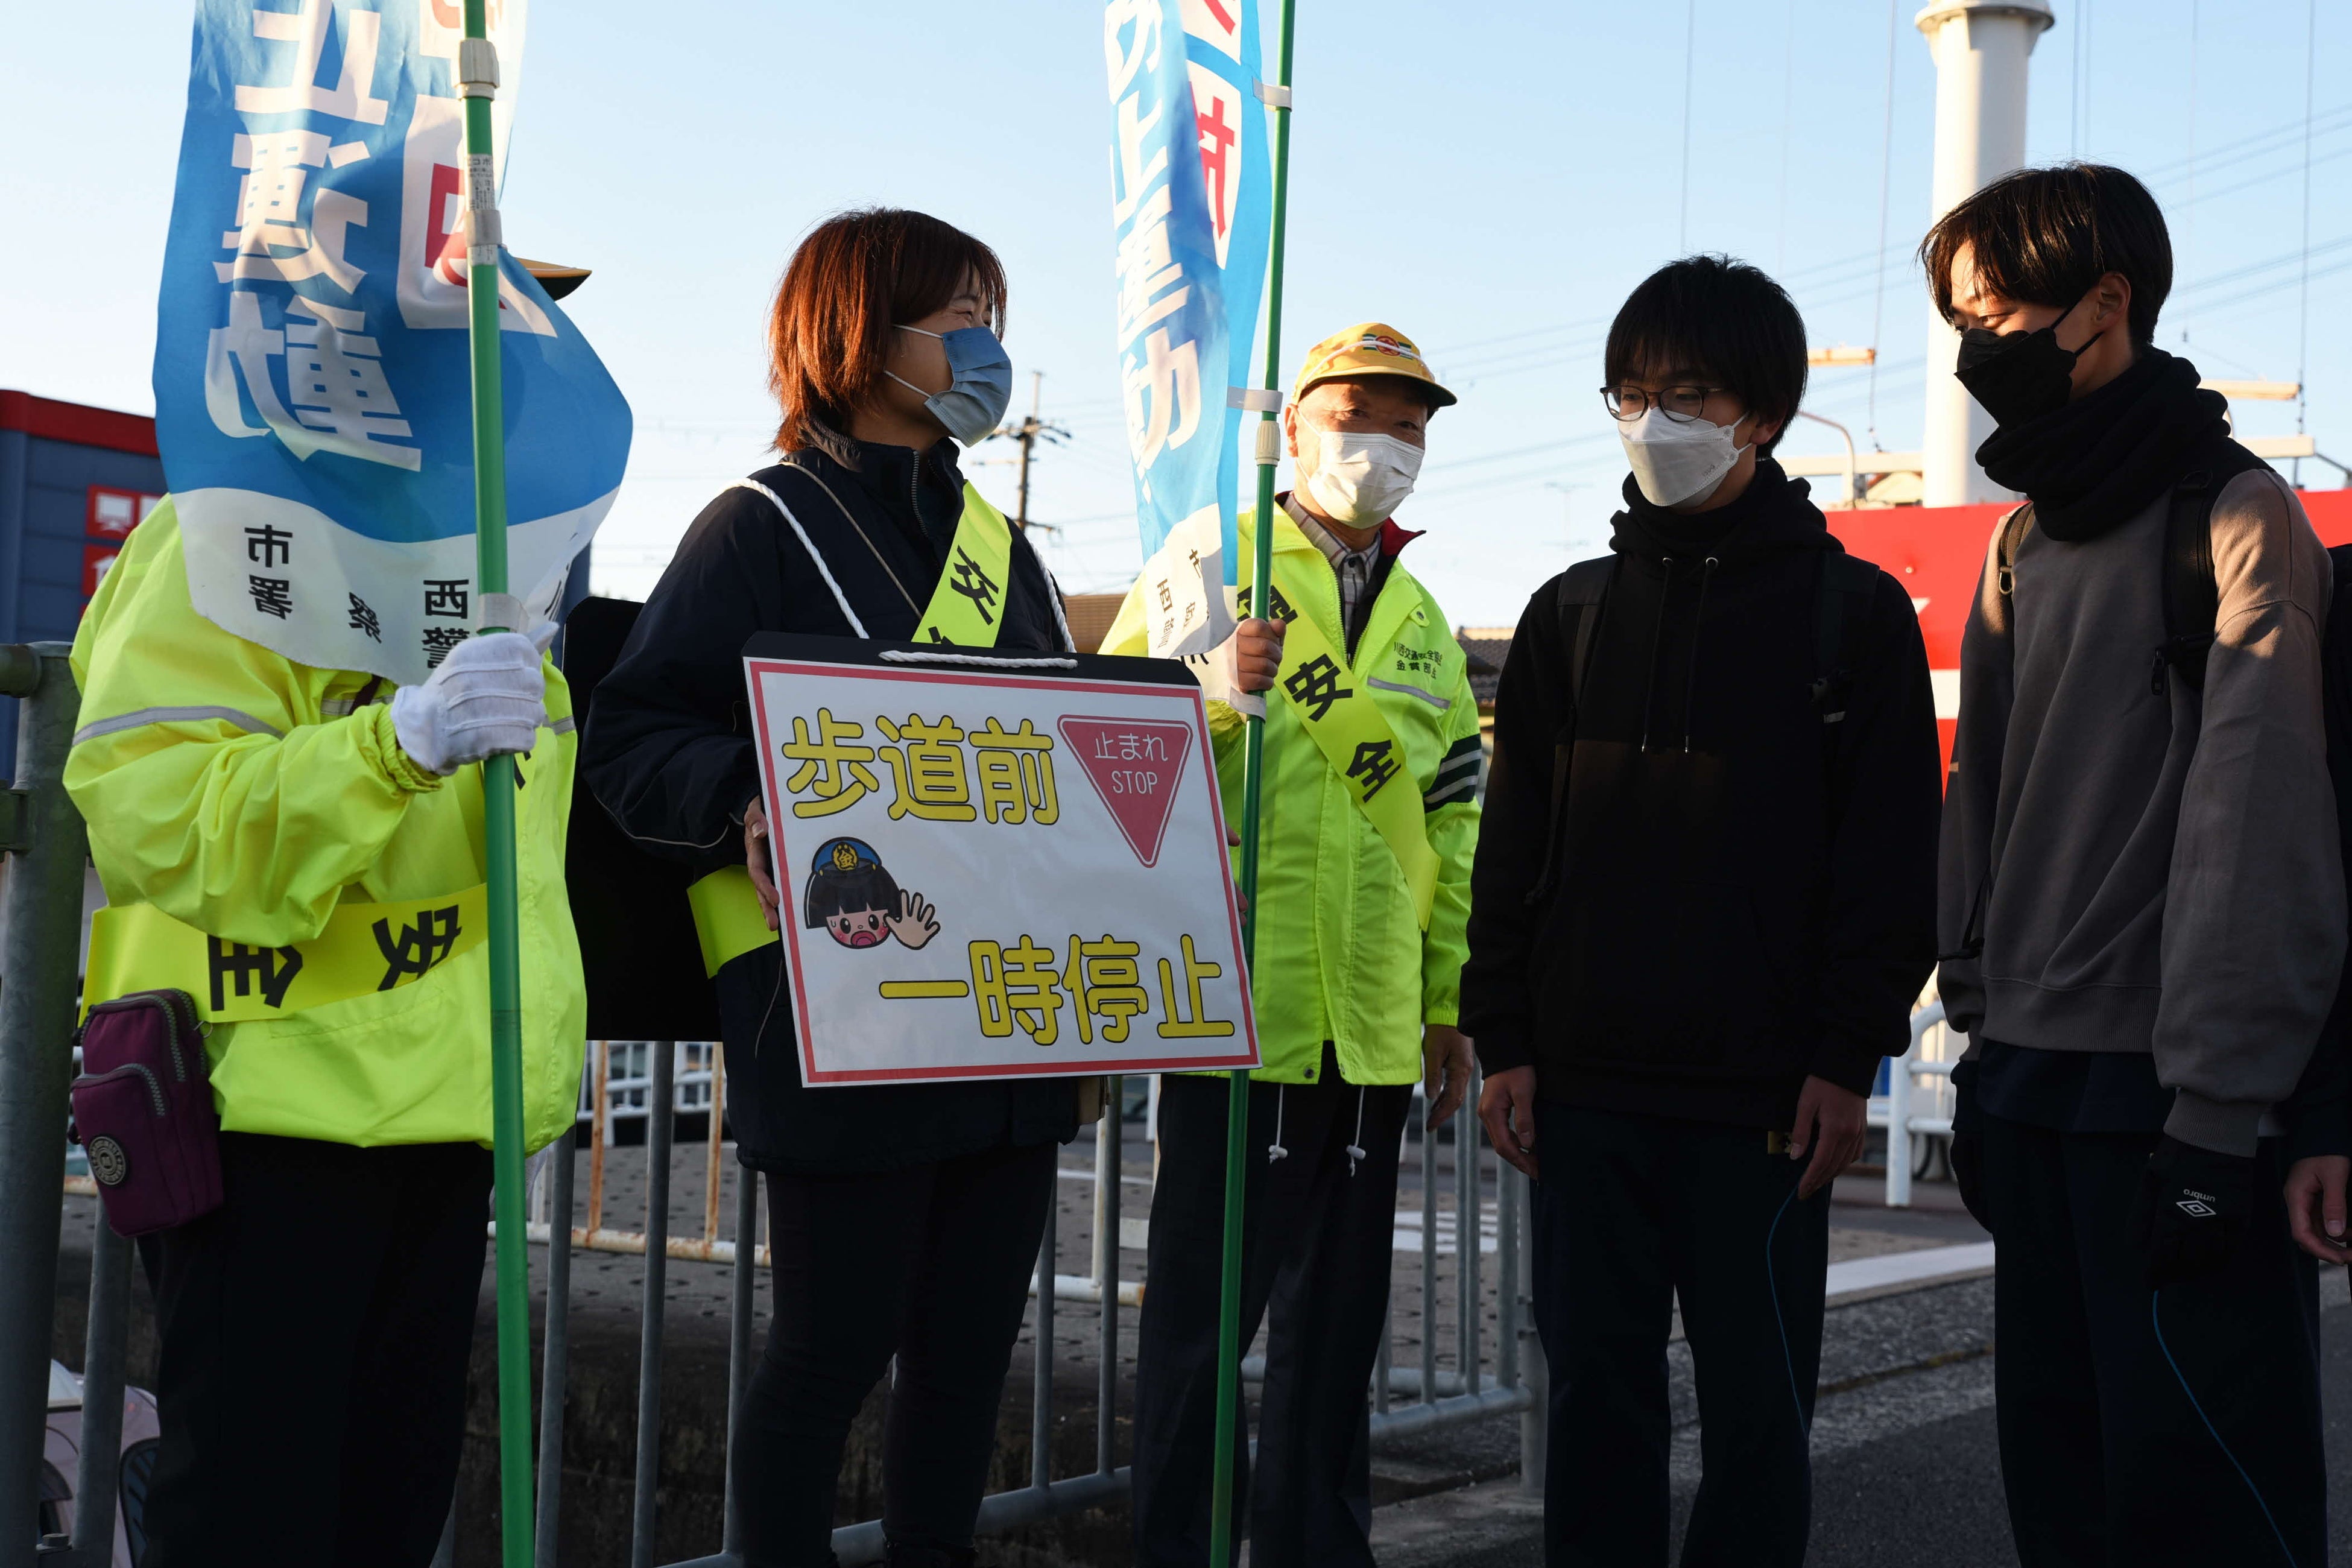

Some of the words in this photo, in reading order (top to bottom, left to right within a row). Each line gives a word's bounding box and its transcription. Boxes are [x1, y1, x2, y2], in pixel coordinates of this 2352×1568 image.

[1095, 732, 1168, 762] 止まれ
[782, 707, 1060, 825] 歩道前
[1111, 770, 1158, 794] STOP
[879, 934, 1235, 1046] 一時停止
[2183, 1189, 2216, 1202] umbro
